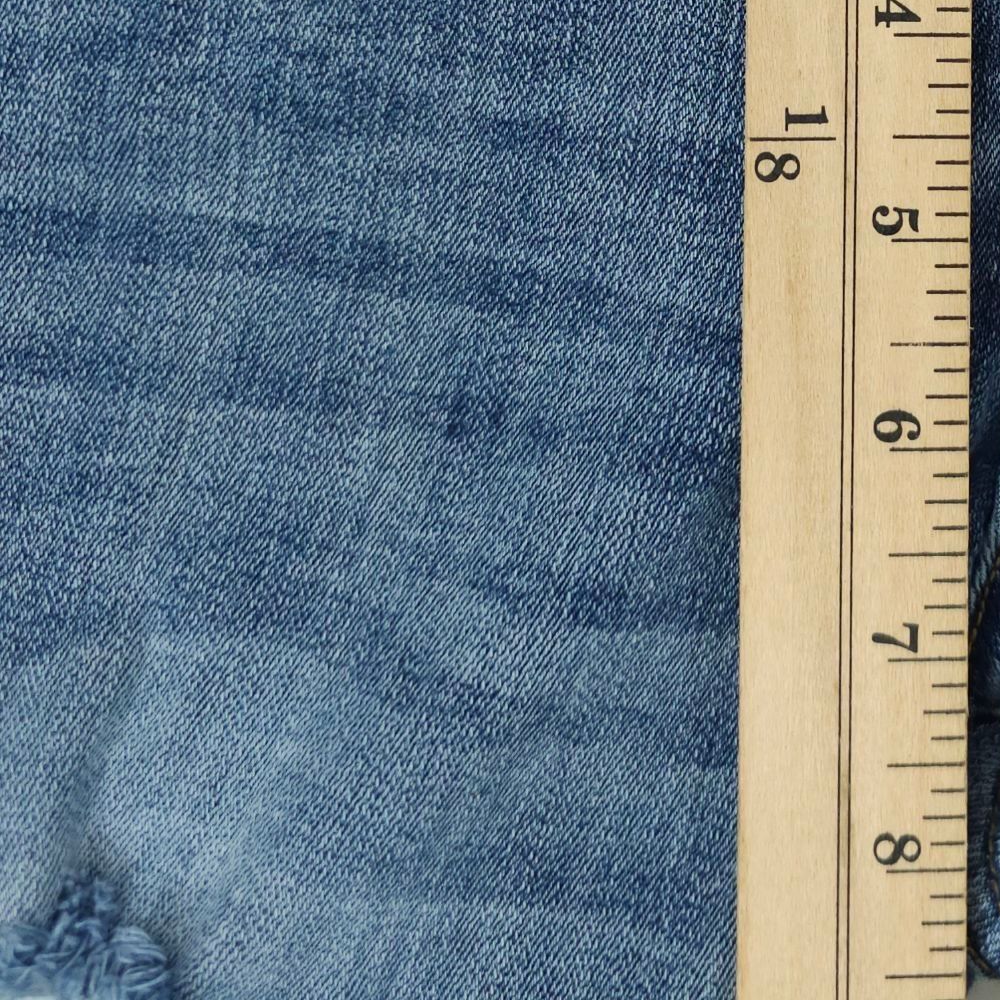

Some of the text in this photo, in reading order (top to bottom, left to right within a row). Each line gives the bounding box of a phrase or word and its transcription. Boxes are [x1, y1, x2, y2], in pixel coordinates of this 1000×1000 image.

[785, 105, 829, 132] 1
[754, 151, 801, 183] 8
[872, 205, 919, 236] 5
[873, 408, 921, 443] 6
[871, 622, 919, 653] 7
[873, 832, 921, 865] 8
